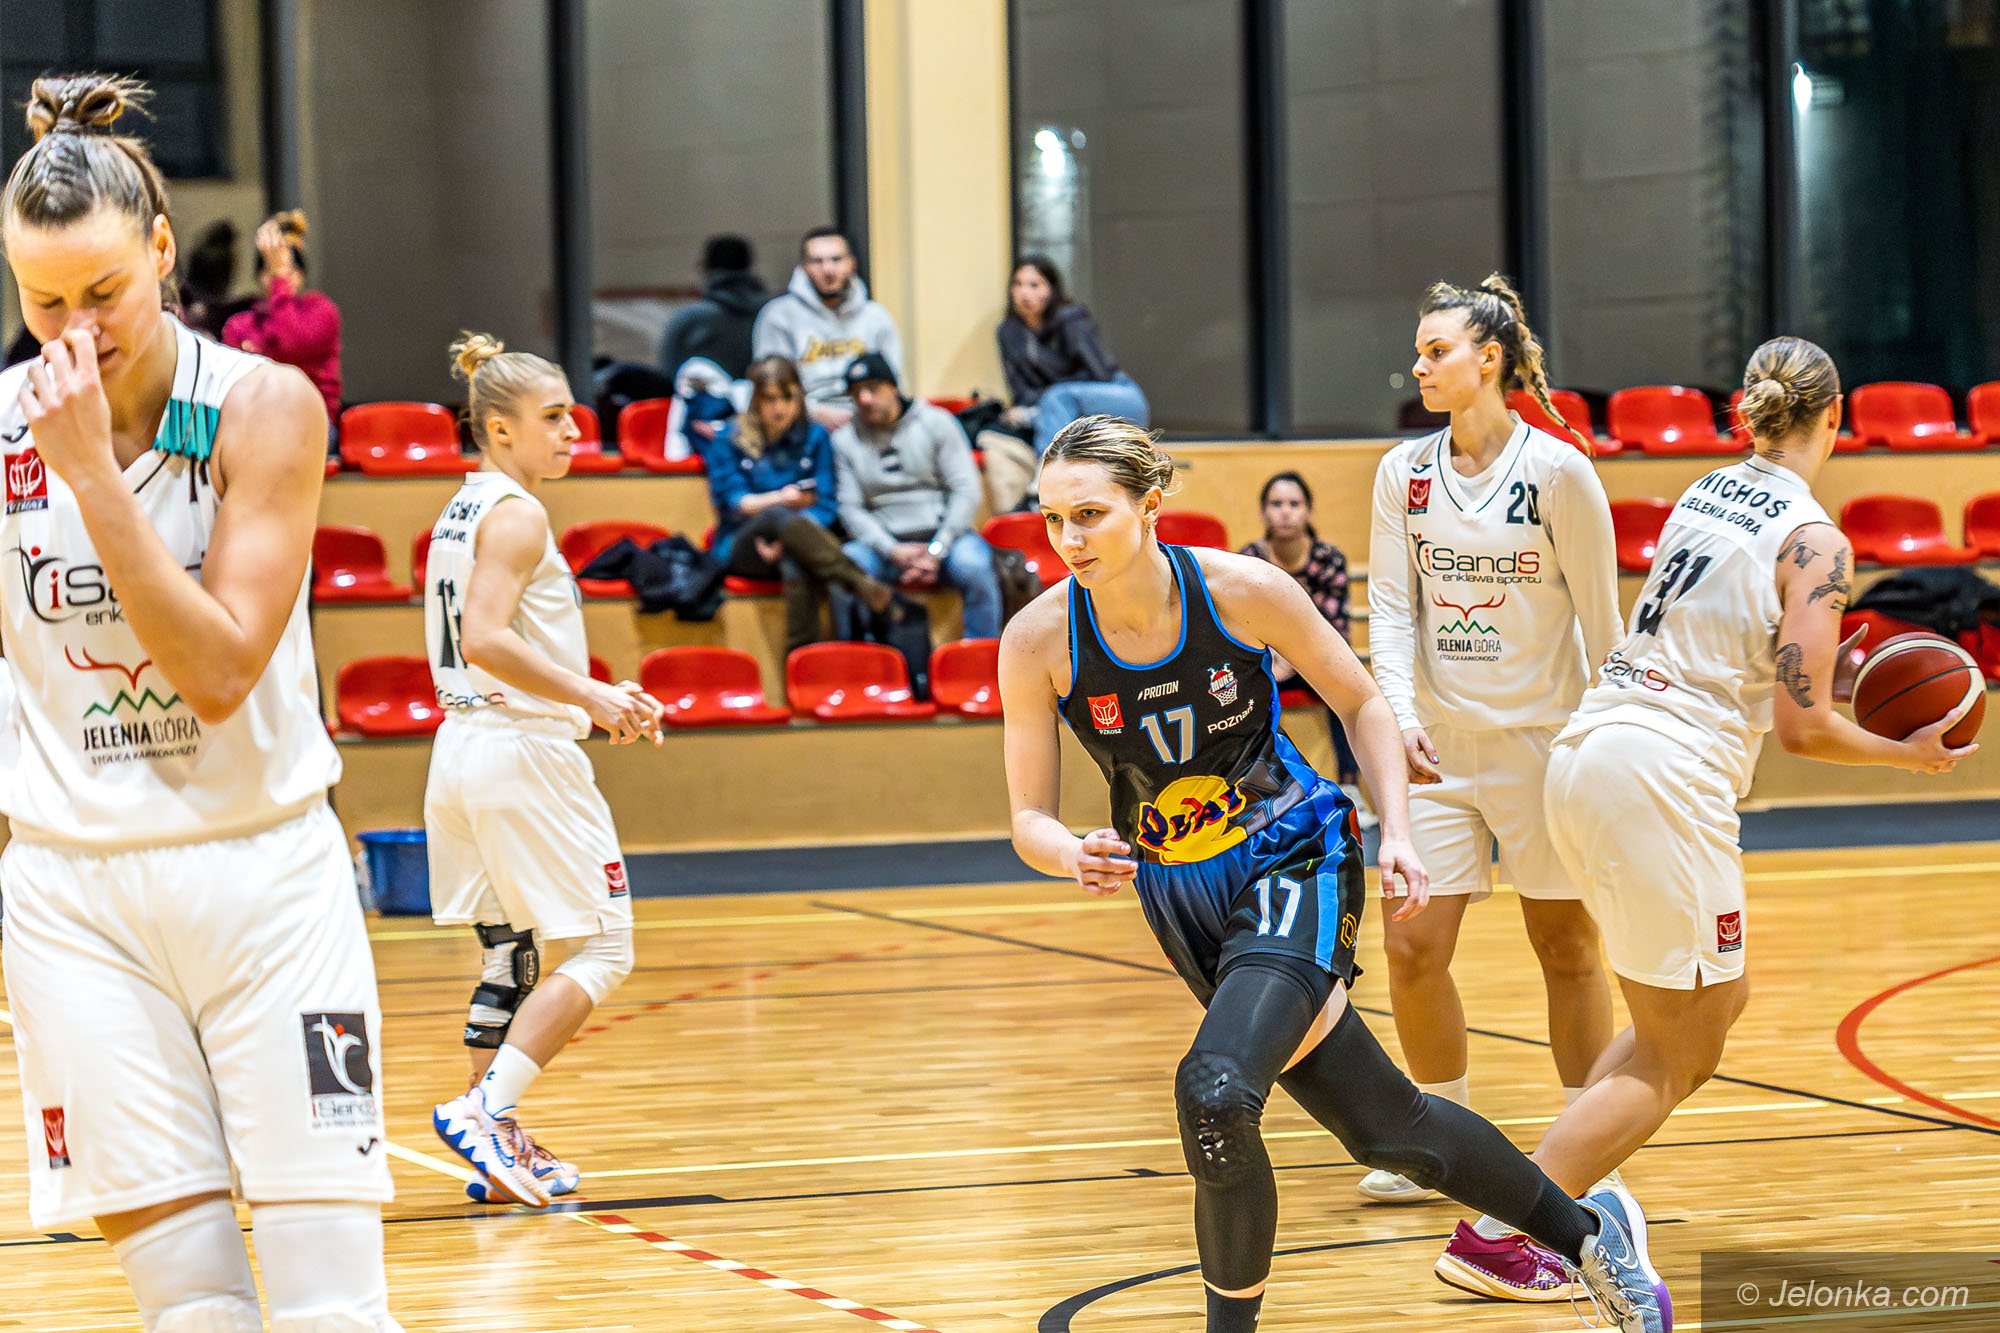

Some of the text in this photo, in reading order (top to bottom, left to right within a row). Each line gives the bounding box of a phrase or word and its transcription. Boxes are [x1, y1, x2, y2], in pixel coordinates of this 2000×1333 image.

[1680, 497, 1763, 536] JELENIA GÓRA
[1425, 547, 1540, 574] iSandS
[1442, 572, 1542, 586] enklawa sportu
[1437, 638, 1473, 653] JELENIA
[1143, 680, 1179, 701] PROTON
[1210, 671, 1235, 693] MUKS
[83, 721, 152, 751] JELENIA
[1139, 704, 1196, 765] 17
[1253, 875, 1303, 939] 17
